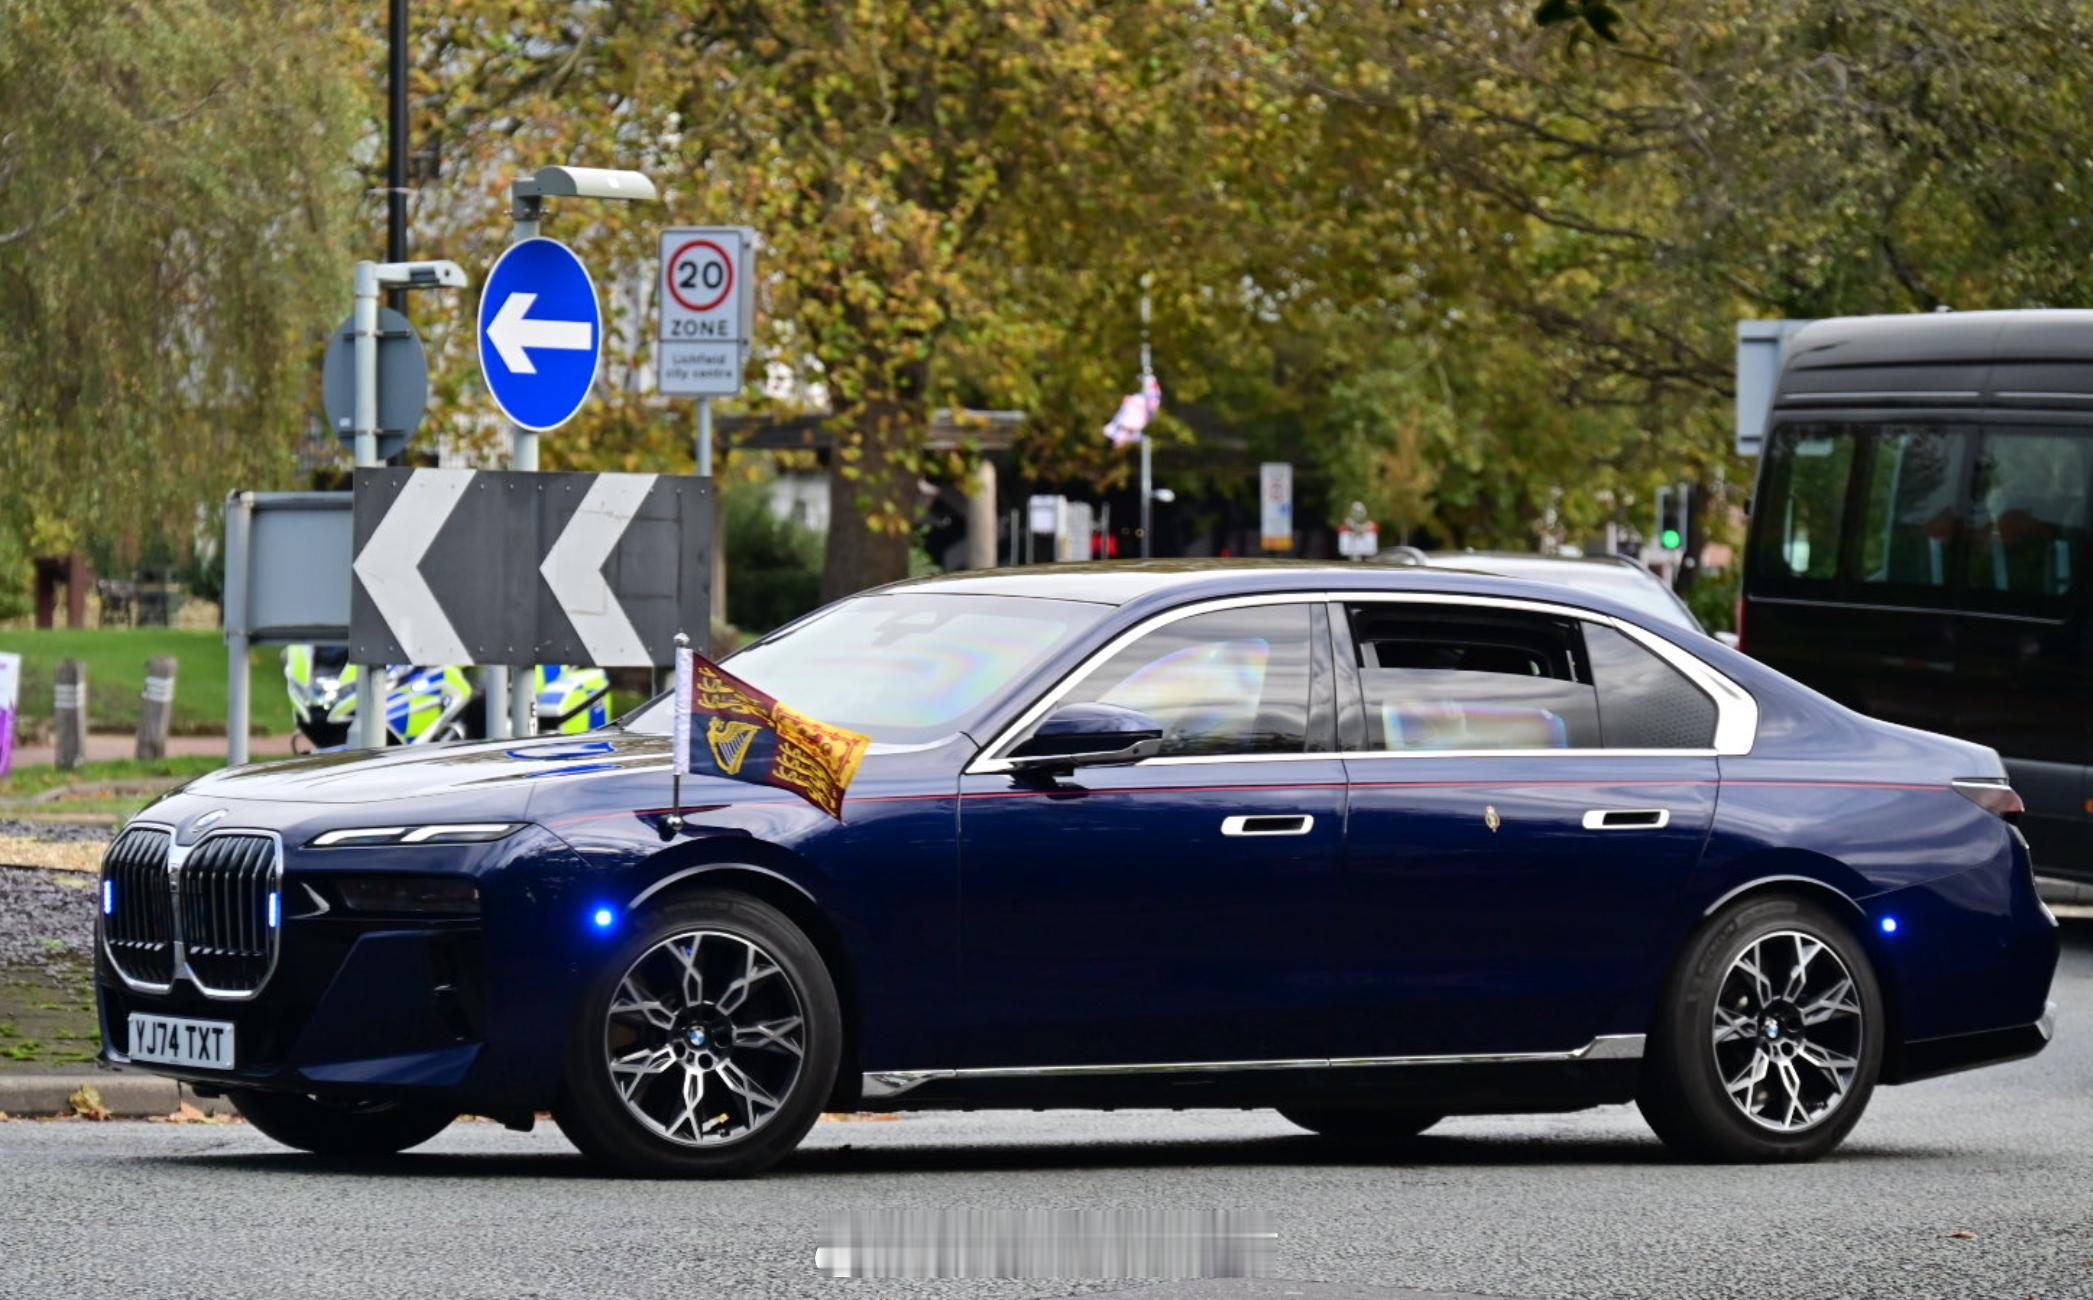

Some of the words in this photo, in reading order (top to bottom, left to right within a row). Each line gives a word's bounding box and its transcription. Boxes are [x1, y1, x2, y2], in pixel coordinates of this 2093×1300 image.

[678, 260, 724, 289] 20
[670, 319, 729, 336] ZONE
[135, 1019, 180, 1058] YJ74
[185, 1025, 224, 1062] TXT
